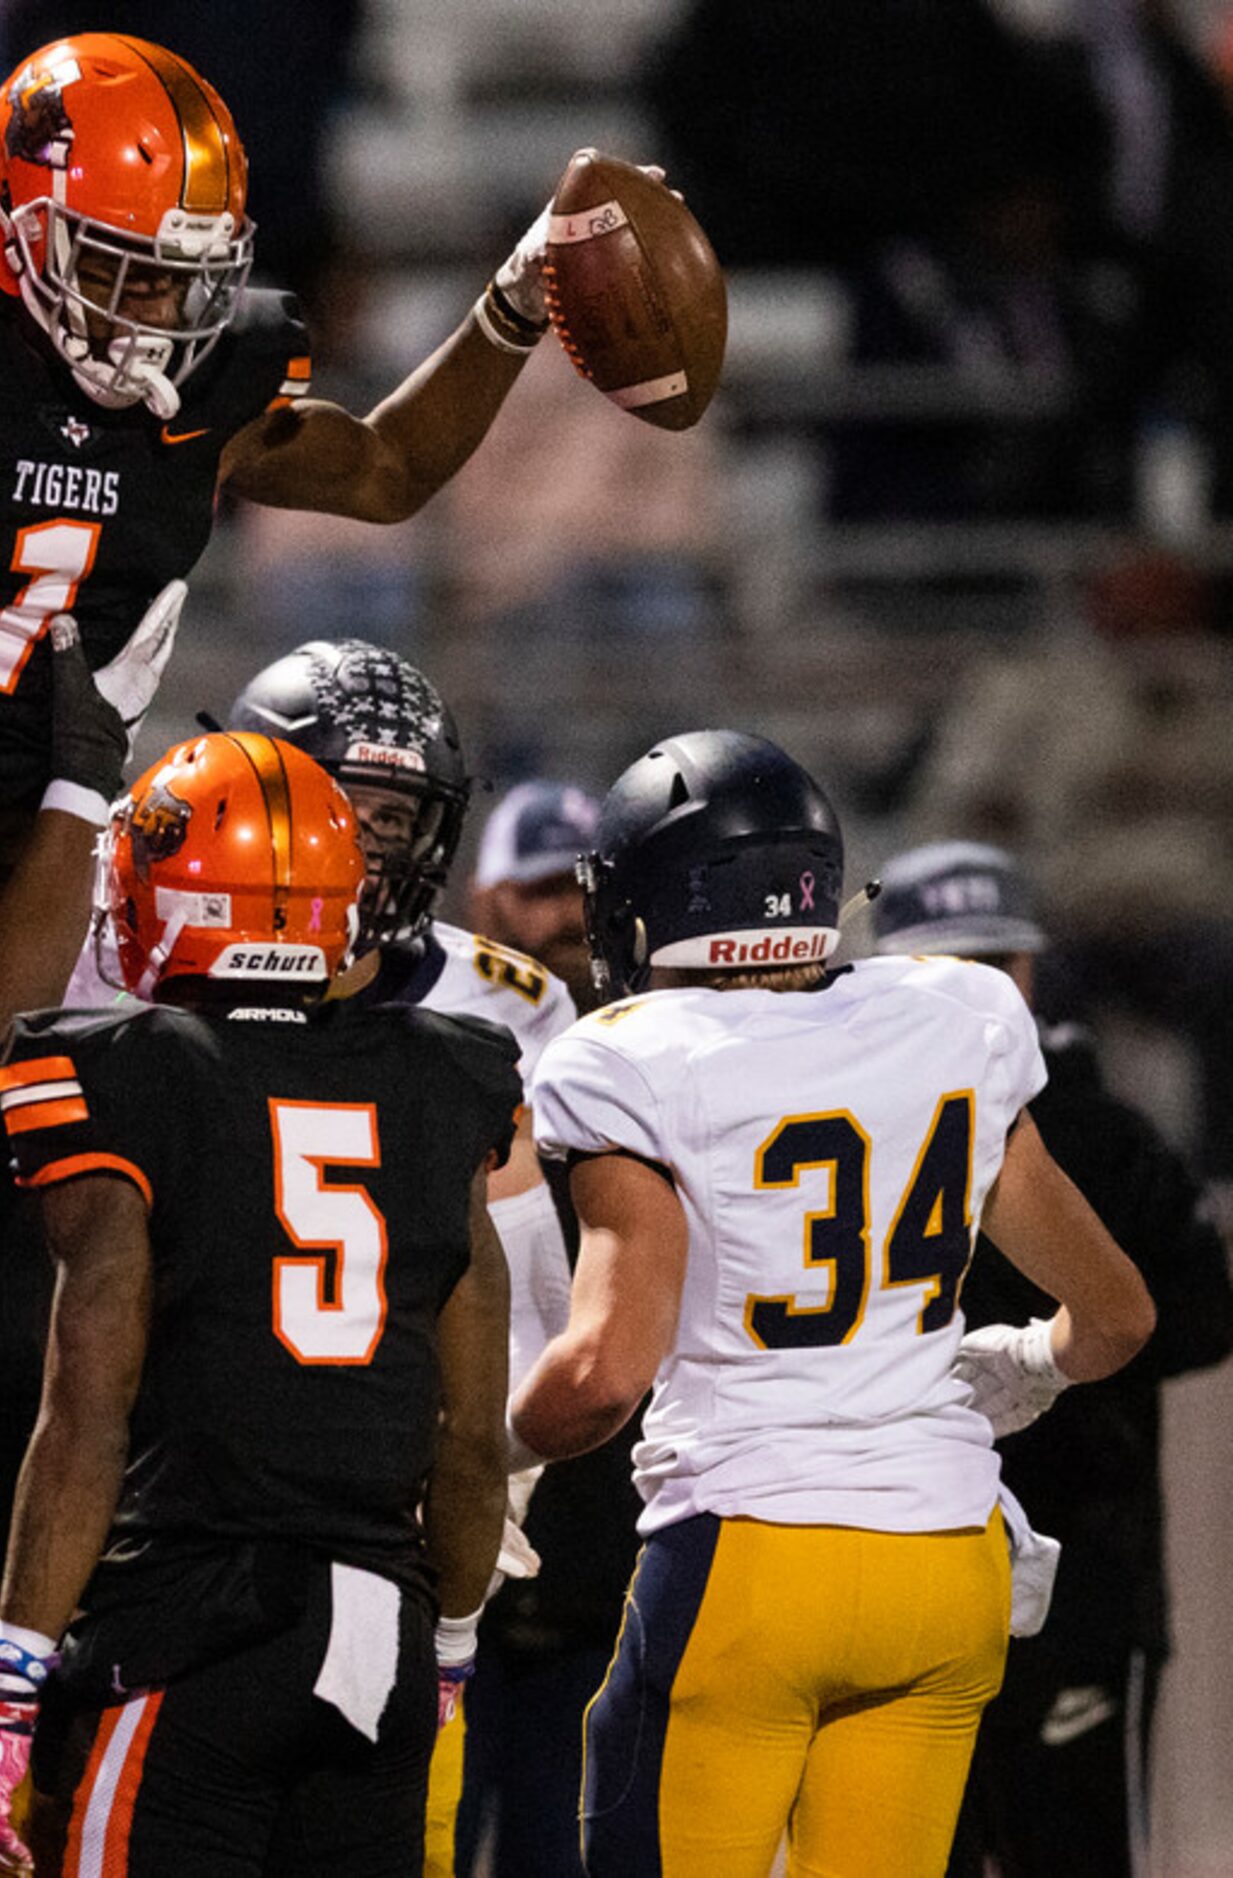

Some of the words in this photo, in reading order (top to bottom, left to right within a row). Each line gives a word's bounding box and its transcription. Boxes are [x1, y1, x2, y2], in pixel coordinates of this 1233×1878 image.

[12, 459, 120, 516] TIGERS
[274, 907, 287, 931] 5
[764, 893, 792, 918] 34
[228, 951, 319, 972] schutt
[708, 933, 827, 964] Riddell
[226, 1006, 308, 1024] ARMOU
[268, 1097, 390, 1365] 5
[742, 1087, 975, 1351] 34
